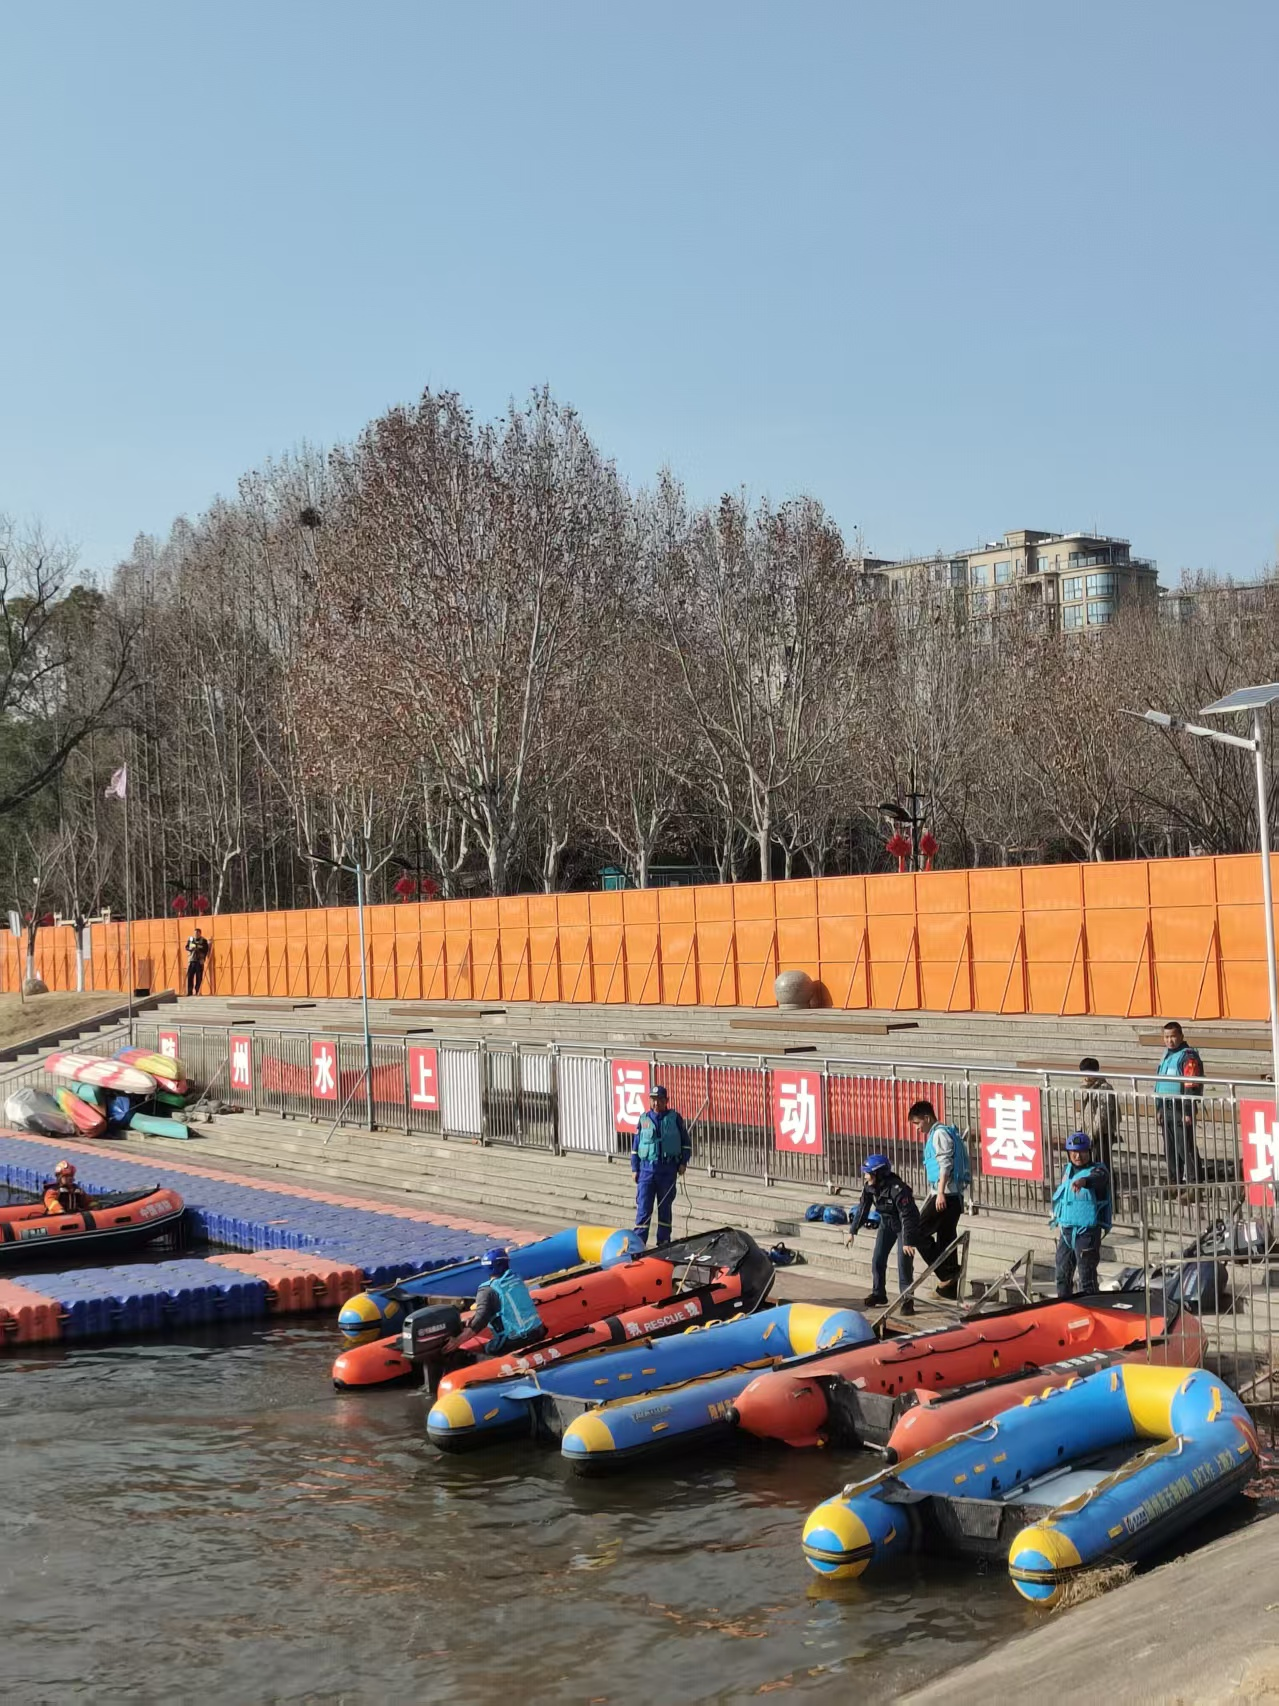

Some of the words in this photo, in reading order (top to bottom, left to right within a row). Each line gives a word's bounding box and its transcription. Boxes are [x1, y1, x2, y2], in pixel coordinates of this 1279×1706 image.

[233, 1041, 249, 1086] 州
[314, 1046, 335, 1094] 水
[413, 1054, 436, 1104] 上
[615, 1067, 646, 1125] 运
[779, 1078, 817, 1145] 动
[986, 1093, 1036, 1172] 基
[643, 1311, 686, 1332] RESCUE
